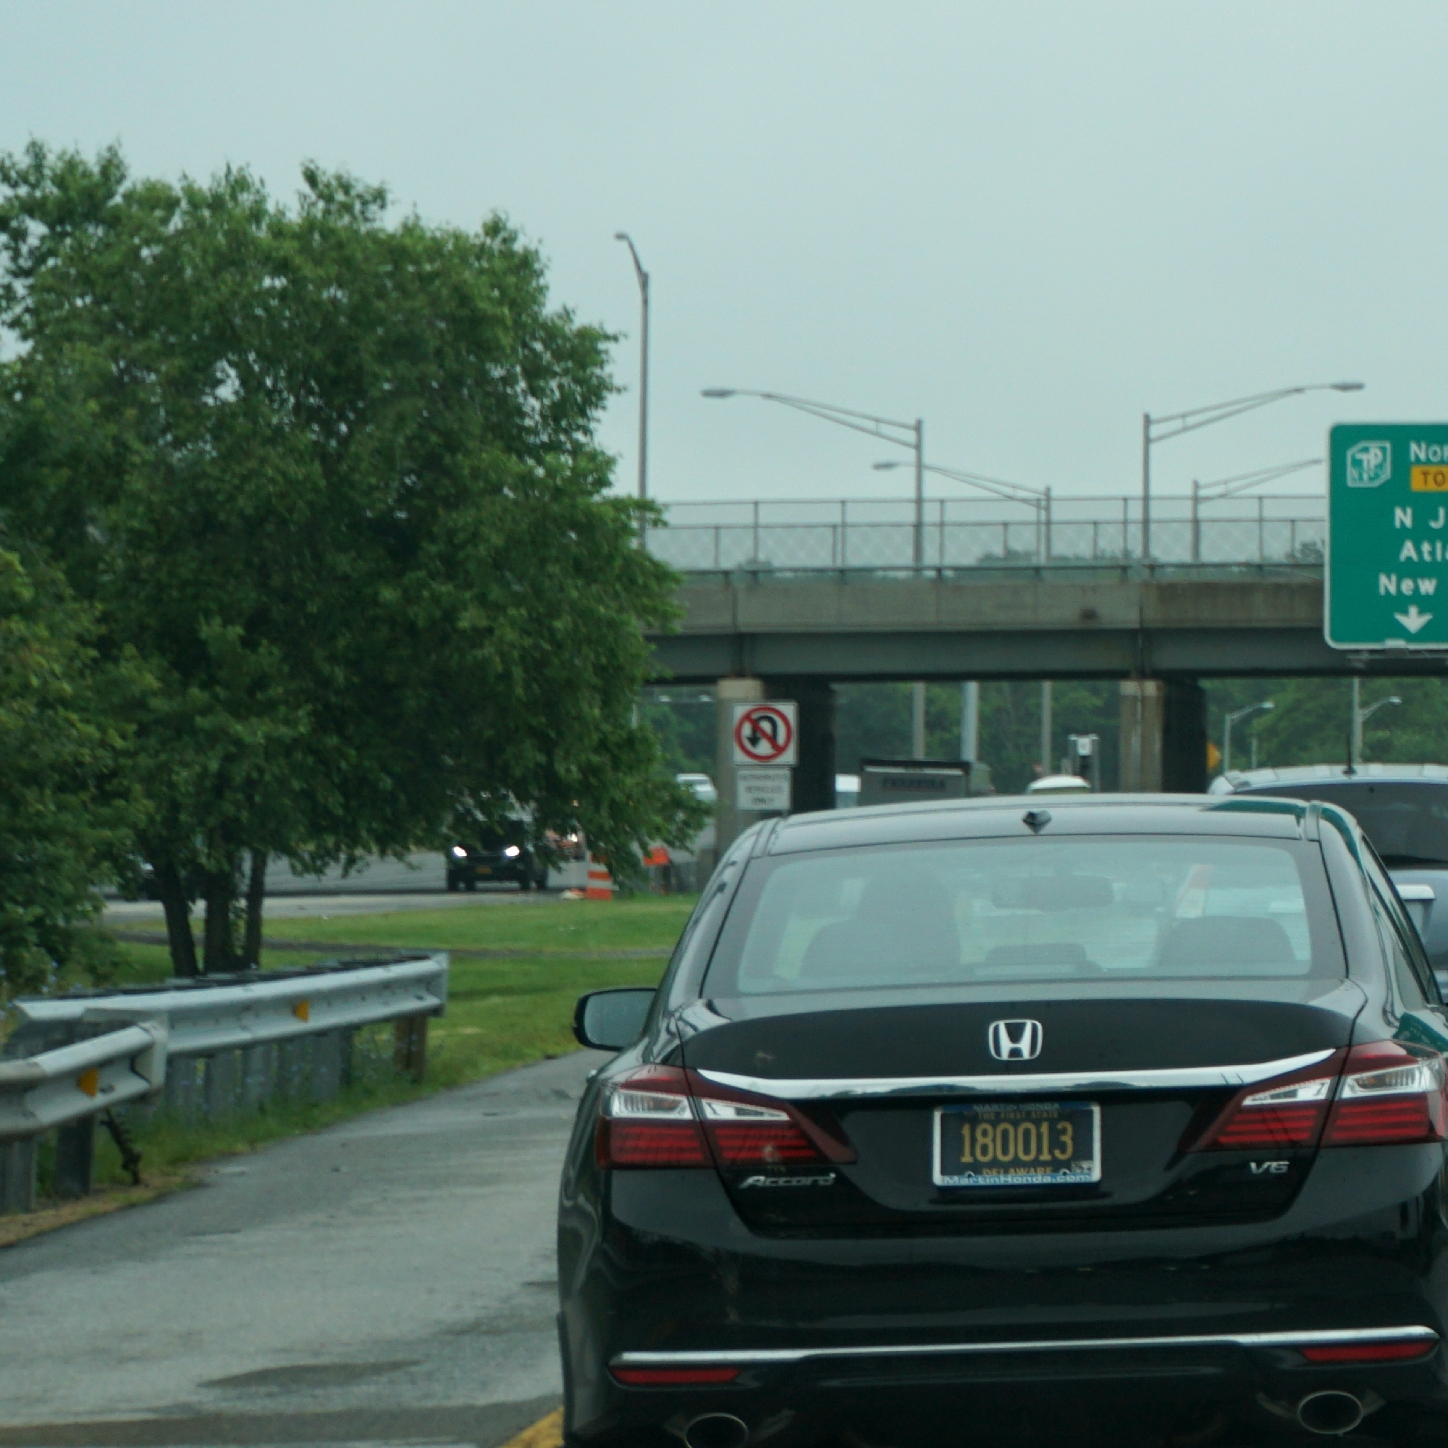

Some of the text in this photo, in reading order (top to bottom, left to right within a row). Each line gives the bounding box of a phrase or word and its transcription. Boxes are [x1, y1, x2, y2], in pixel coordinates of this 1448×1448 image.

[1378, 573, 1438, 596] New
[960, 1120, 1074, 1163] 180013
[982, 1166, 1054, 1176] DELAWARE
[1249, 1160, 1290, 1174] V6
[739, 1173, 837, 1189] Accord
[942, 1173, 1092, 1185] MartinHonda.com
